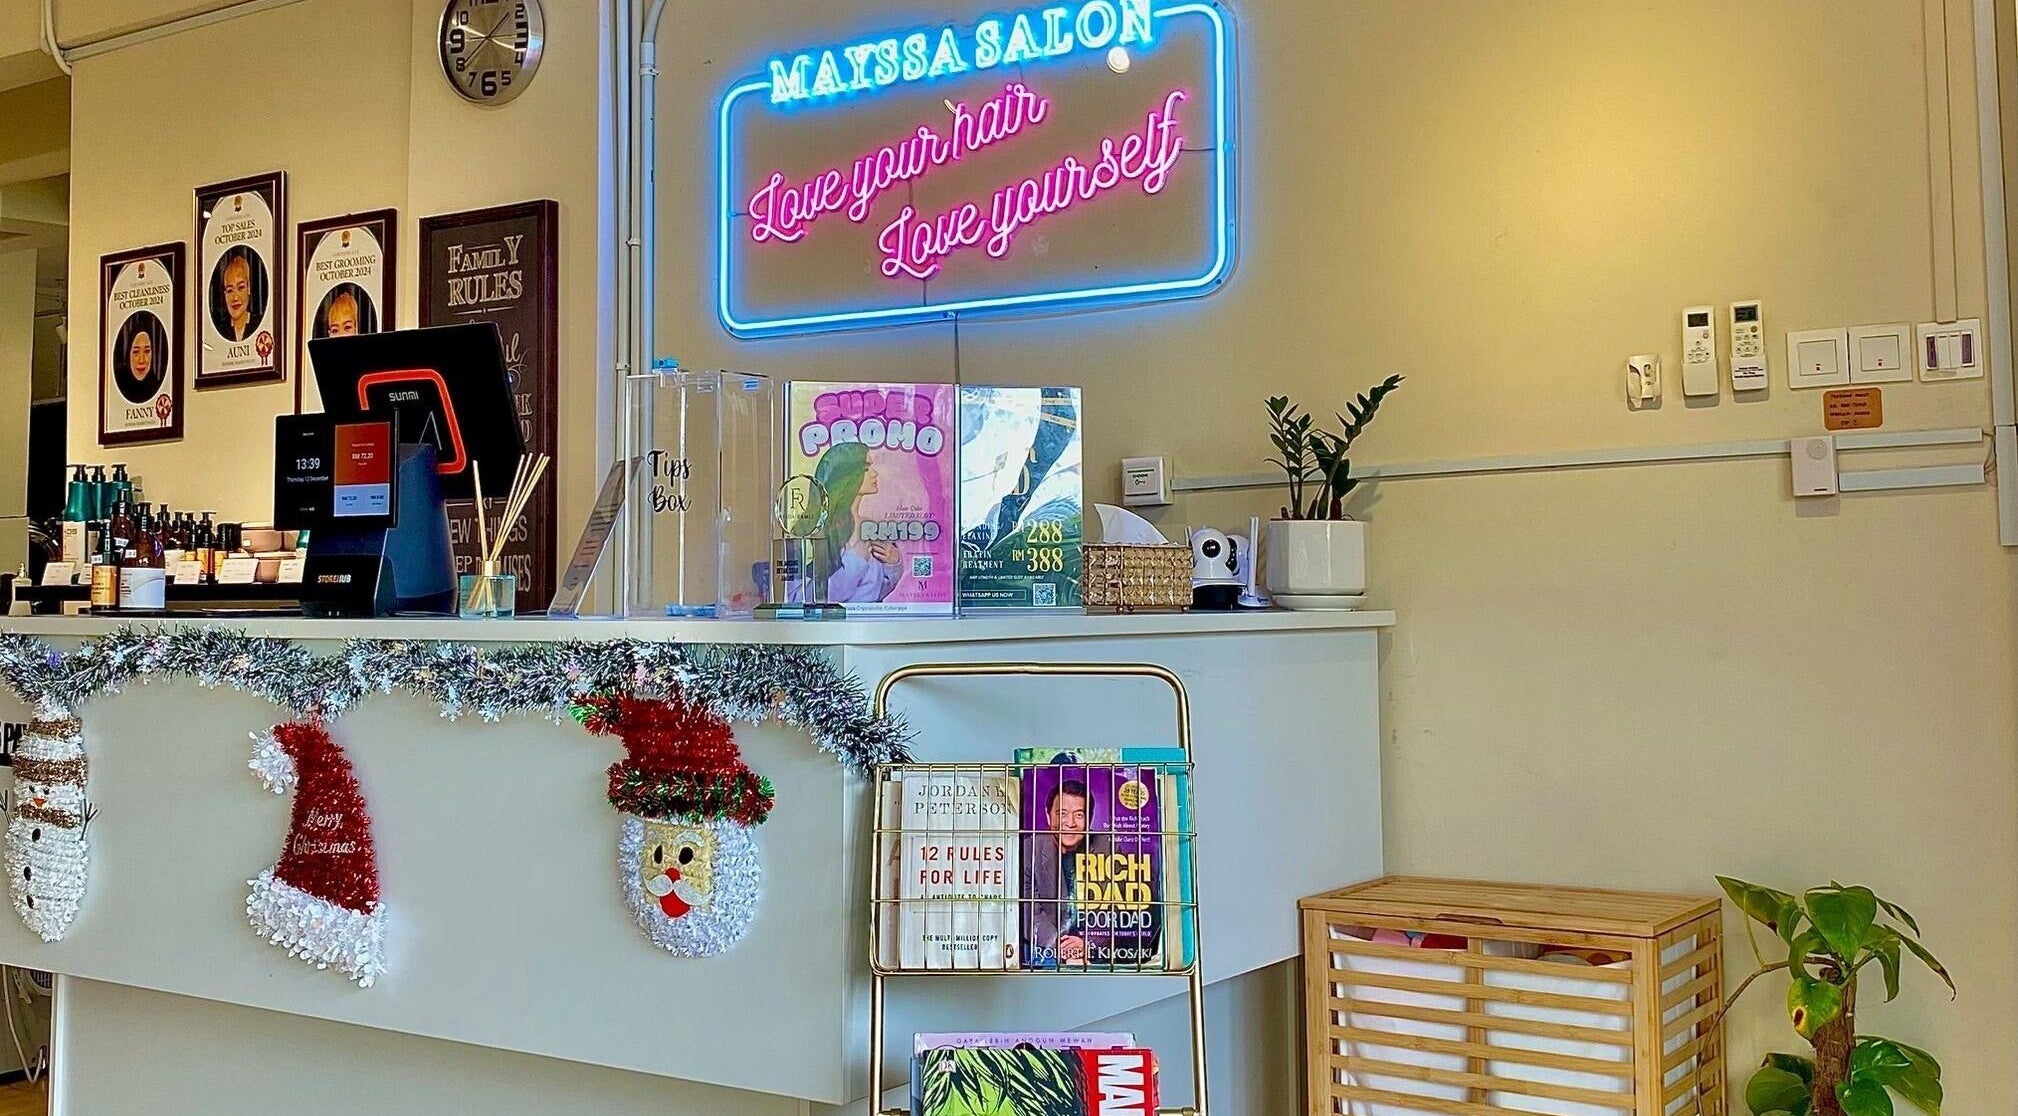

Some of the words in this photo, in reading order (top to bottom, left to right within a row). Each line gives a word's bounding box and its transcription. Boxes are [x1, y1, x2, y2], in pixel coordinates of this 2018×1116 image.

[450, 28, 465, 54] 9
[770, 28, 966, 103] MAYSSA
[975, 0, 1153, 65] SALON
[456, 57, 465, 72] 8
[468, 72, 477, 87] 7
[481, 71, 497, 96] 6
[501, 70, 511, 86] 5
[749, 173, 851, 242] Love
[847, 127, 947, 222] your
[942, 83, 1047, 160] hair
[879, 203, 986, 279] Love
[986, 90, 1187, 258] yourself
[221, 223, 234, 233] TOP
[236, 219, 256, 231] SALES
[215, 232, 246, 245] OCTOBER
[248, 229, 262, 239] 2024
[316, 260, 332, 271] BEST
[334, 254, 376, 269] GROOMING
[320, 269, 354, 281] OCTOBER
[355, 266, 371, 277] 2024
[114, 290, 128, 301] BEST
[129, 284, 170, 299] CLEANLINESS
[448, 270, 523, 306] RULES
[119, 299, 149, 310] OCTOBER
[150, 296, 163, 306] 2024
[227, 345, 250, 358] AUNI
[126, 406, 154, 420] FANNY
[814, 390, 934, 426] SUPER
[799, 417, 944, 457] PROMO
[296, 458, 320, 470] 13:39
[647, 450, 692, 487] Tips
[648, 485, 691, 512] Box
[450, 518, 471, 544] EW
[474, 515, 528, 543] THIGS
[860, 520, 941, 541] RM199
[1027, 519, 1062, 543] 288
[962, 561, 1003, 569] REATMENT
[1012, 550, 1025, 561] RM
[1027, 547, 1063, 572] 388
[919, 785, 990, 798] JORDAN
[914, 802, 1011, 815] PETERSON
[302, 807, 343, 831] Merry
[921, 847, 939, 861] 12
[947, 847, 1004, 861] RULES
[1076, 853, 1151, 881] RICH
[920, 870, 953, 885] FOR
[964, 870, 1002, 885] LIFE
[1076, 882, 1151, 910] DAD
[1077, 911, 1118, 928] POOR
[1120, 911, 1151, 928] DAD
[982, 934, 998, 942] COPY
[942, 943, 978, 951] BESTSELLER
[1097, 1054, 1145, 1116] MA
